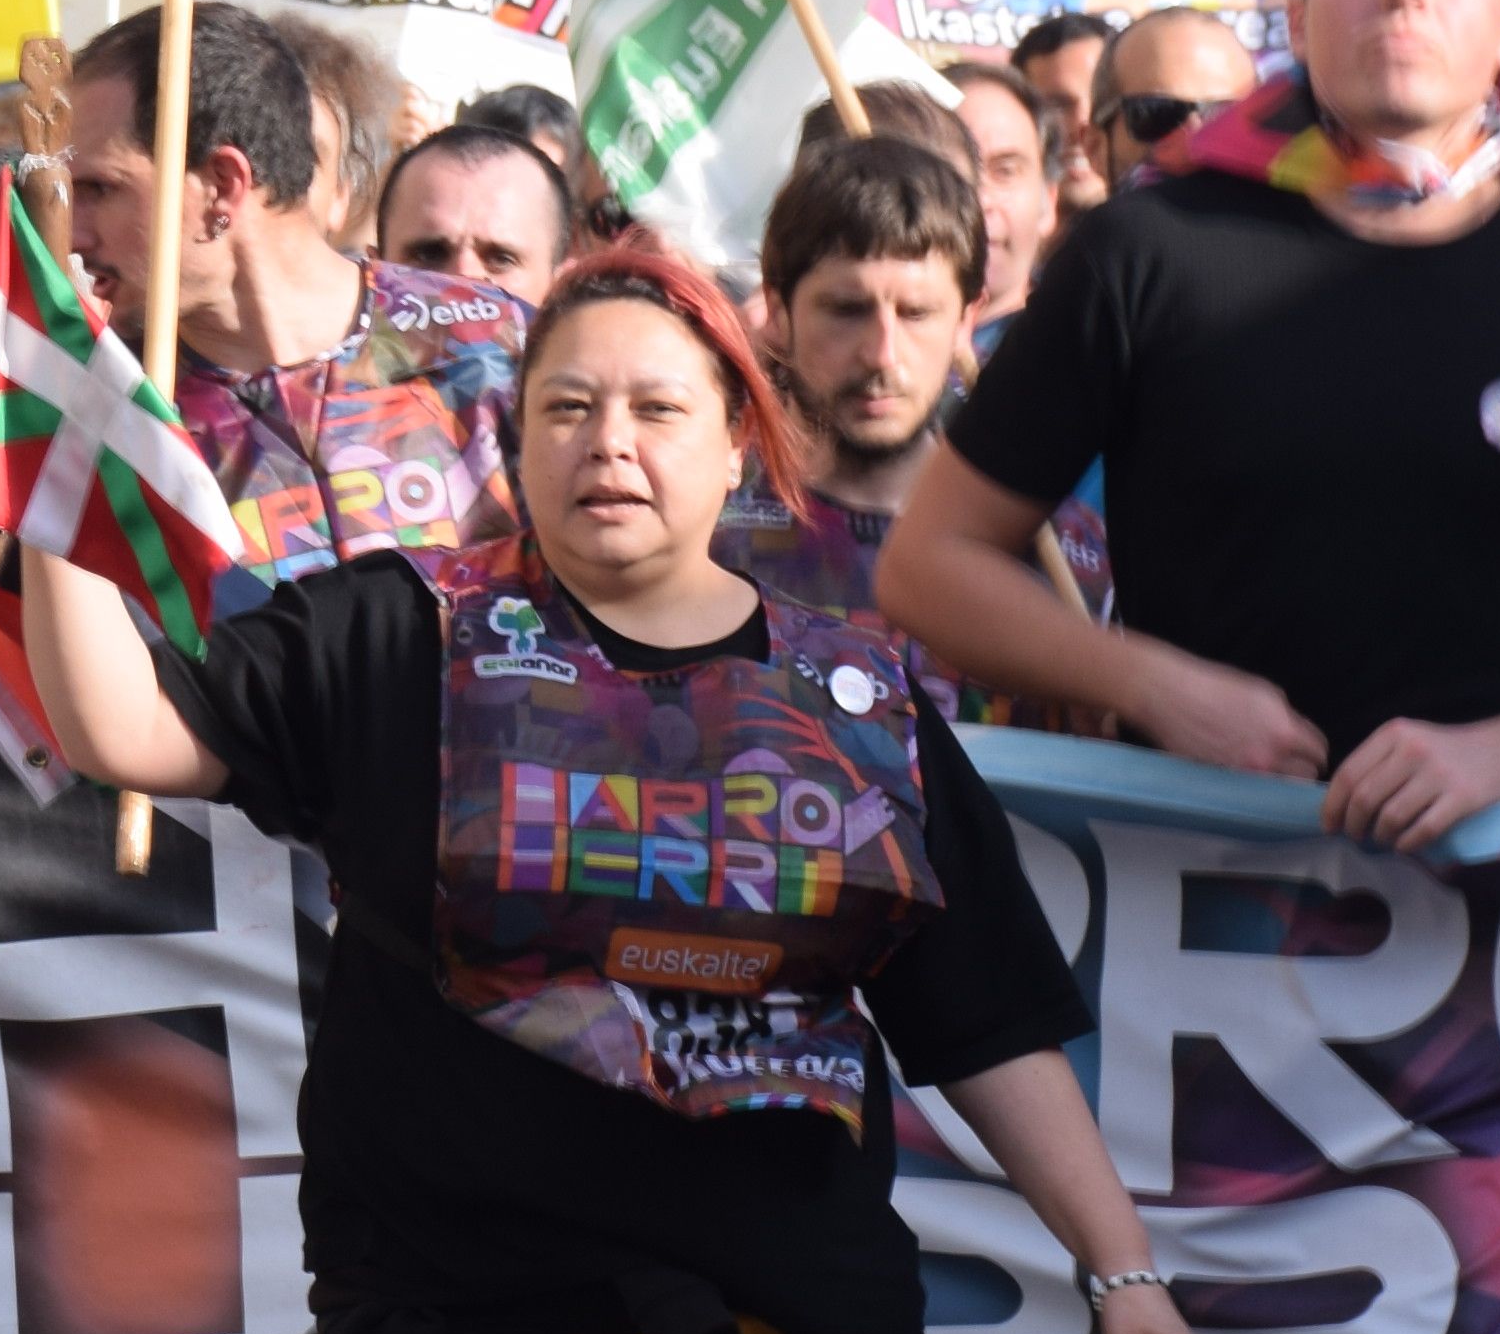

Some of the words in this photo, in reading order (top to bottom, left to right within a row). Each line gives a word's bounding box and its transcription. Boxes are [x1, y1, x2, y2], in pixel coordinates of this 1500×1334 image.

[429, 297, 500, 327] eitb
[502, 762, 843, 850] HARRO
[495, 823, 844, 917] HERRI
